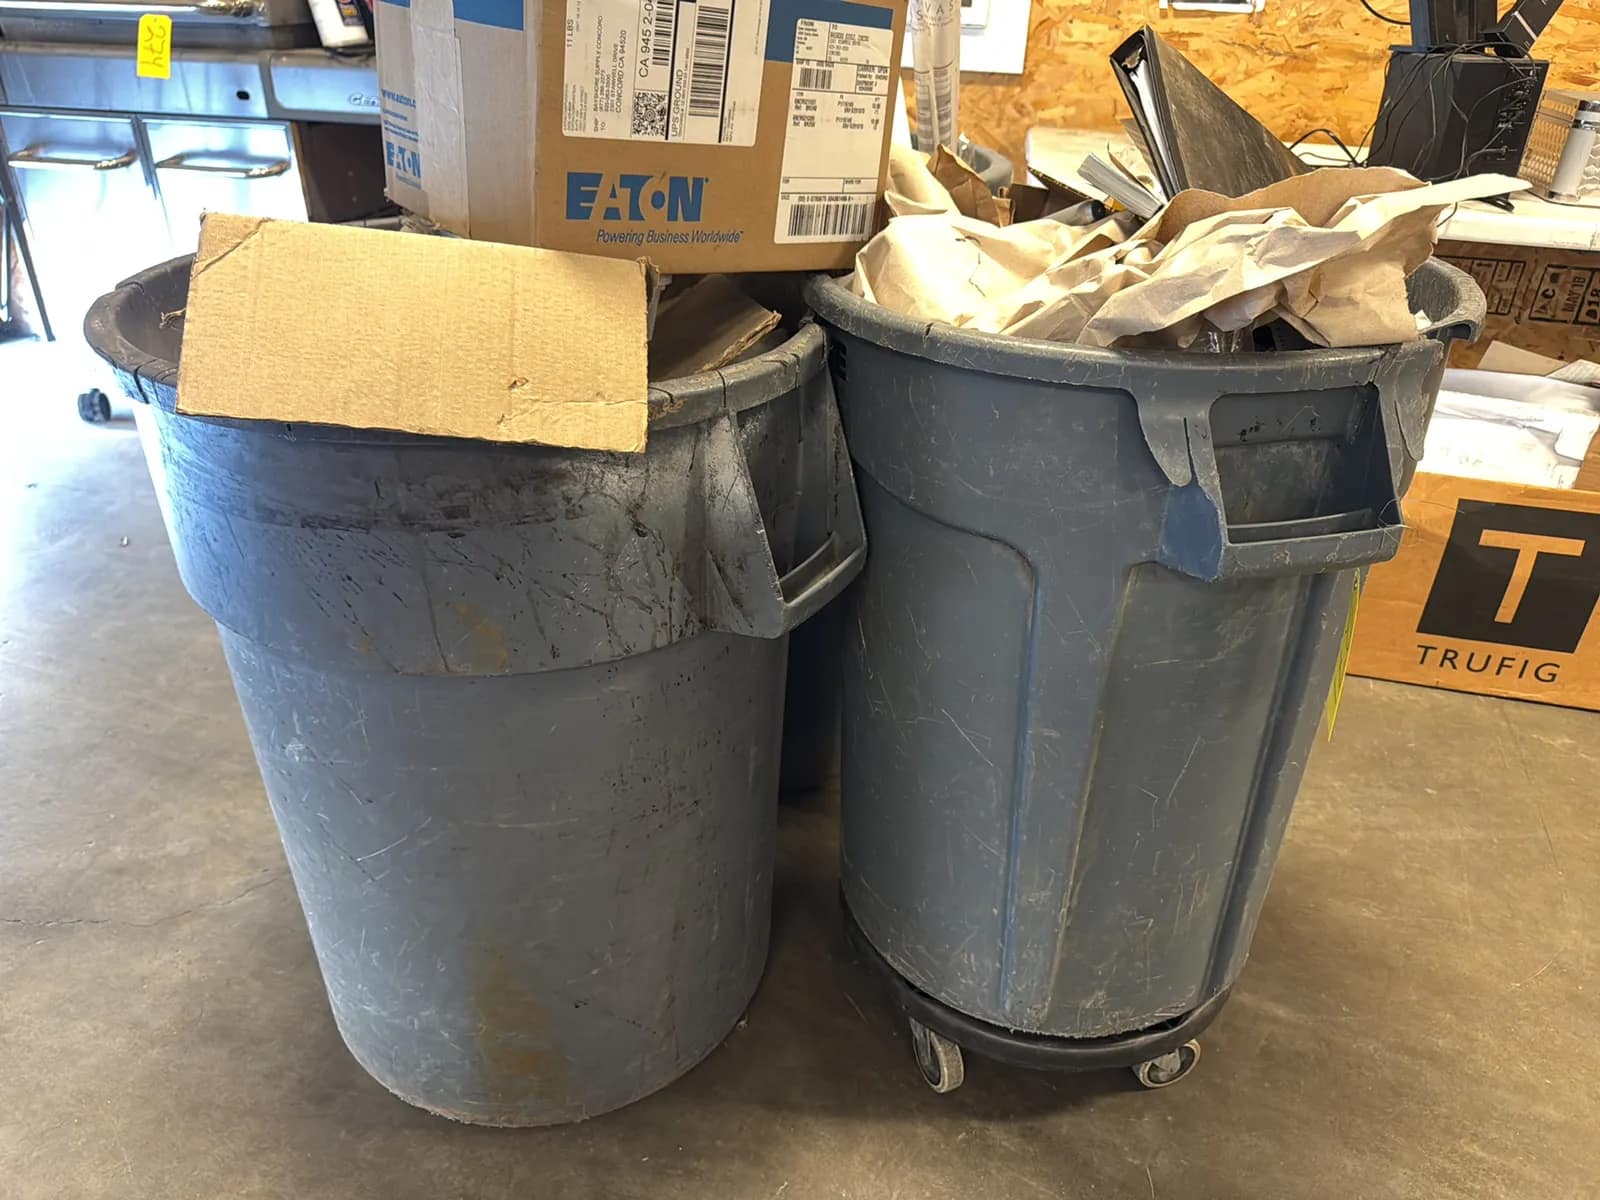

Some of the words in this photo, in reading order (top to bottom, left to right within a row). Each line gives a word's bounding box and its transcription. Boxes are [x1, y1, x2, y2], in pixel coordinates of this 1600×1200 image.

[619, 30, 627, 54] 94520
[641, 29, 652, 53] 945
[618, 56, 624, 68] CA
[638, 58, 650, 78] CA
[616, 70, 624, 113] CONCORD
[673, 69, 683, 114] GROUND
[386, 141, 421, 178] EATON
[566, 172, 704, 222] EATON
[596, 229, 644, 246] Powering
[646, 230, 689, 244] Business
[1478, 528, 1586, 624] T
[1417, 644, 1560, 682] TRUFIG
